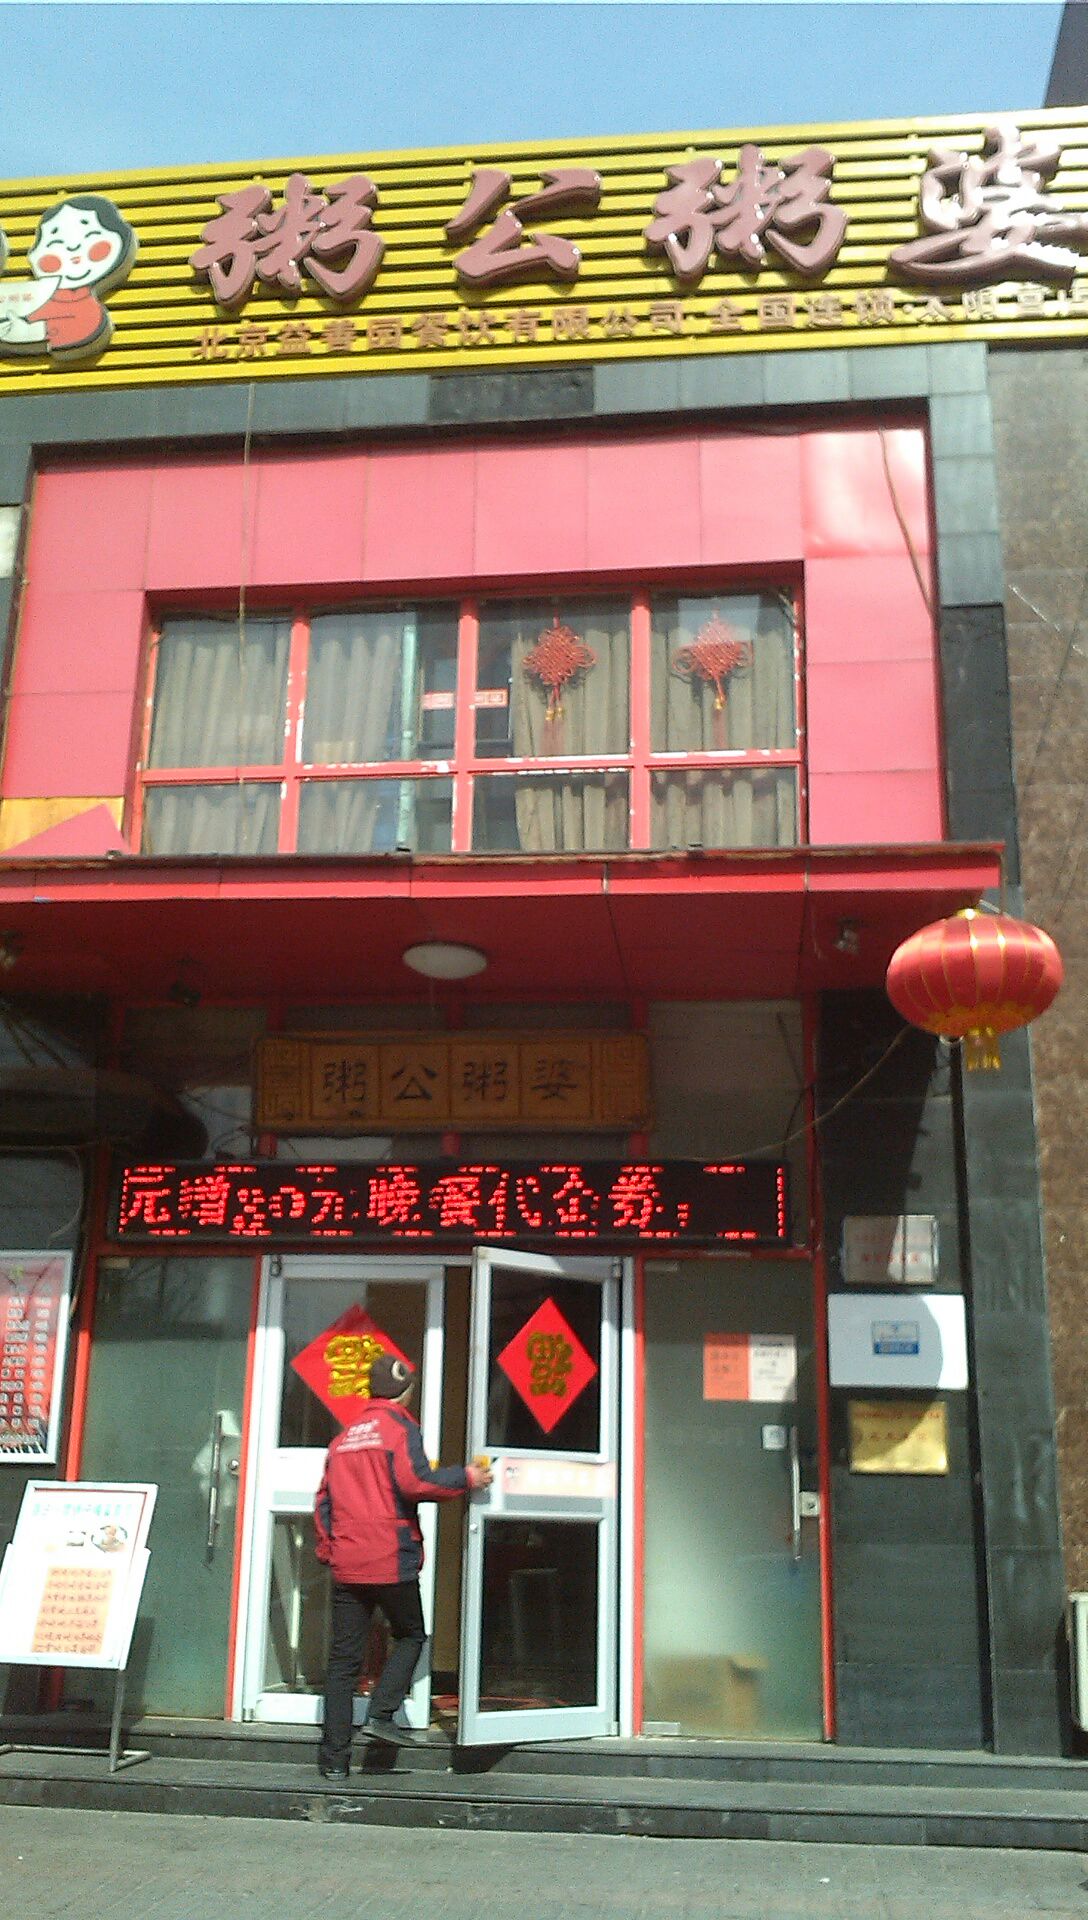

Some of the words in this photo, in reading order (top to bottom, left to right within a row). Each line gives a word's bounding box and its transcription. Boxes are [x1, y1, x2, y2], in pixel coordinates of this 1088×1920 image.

[189, 126, 1088, 311] 粥公粥婆
[323, 1058, 580, 1104] 粥公粥婆
